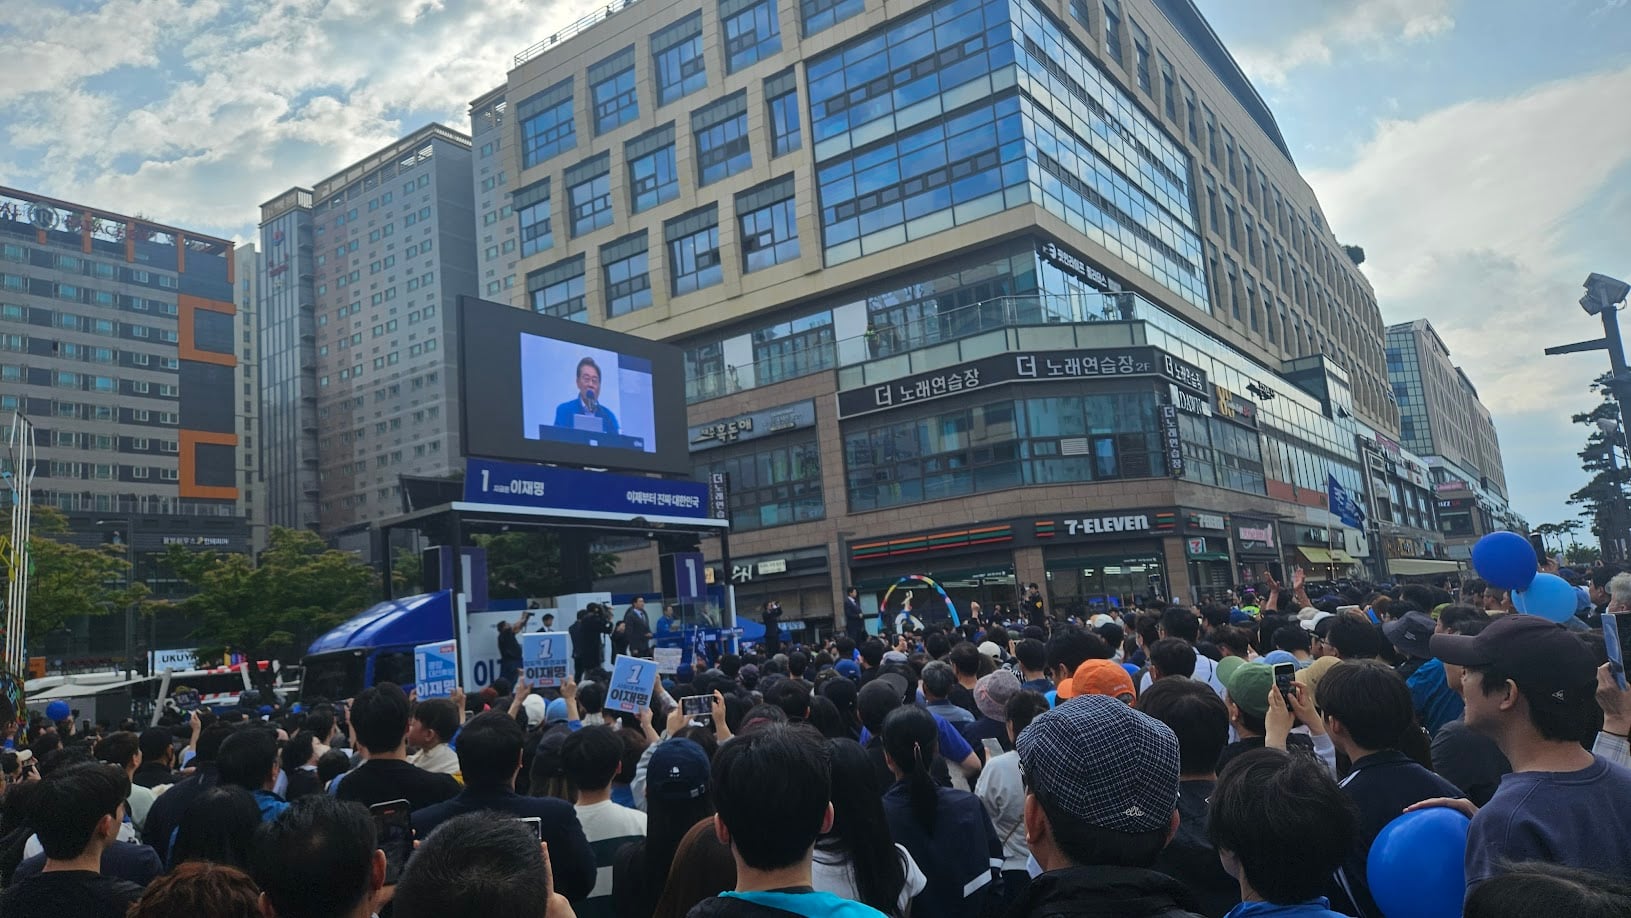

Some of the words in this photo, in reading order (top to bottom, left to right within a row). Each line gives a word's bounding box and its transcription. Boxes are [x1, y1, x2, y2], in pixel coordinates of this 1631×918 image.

[1016, 355, 1037, 377] 더
[1047, 355, 1134, 376] 노래연습장
[1135, 362, 1151, 372] 2F
[1165, 354, 1174, 377] 더
[875, 384, 892, 406] 더
[900, 368, 980, 402] 노래연습장
[481, 469, 490, 492] 1
[510, 479, 545, 496] 이재명
[626, 490, 657, 505] 이제부터
[672, 494, 700, 508] 대한민국
[685, 558, 698, 597] 1
[537, 637, 553, 660] 1
[415, 652, 426, 681] 1
[526, 666, 566, 680] 이재명
[626, 664, 644, 685] 1
[416, 680, 456, 697] 이재명
[610, 689, 649, 706] 이재명
